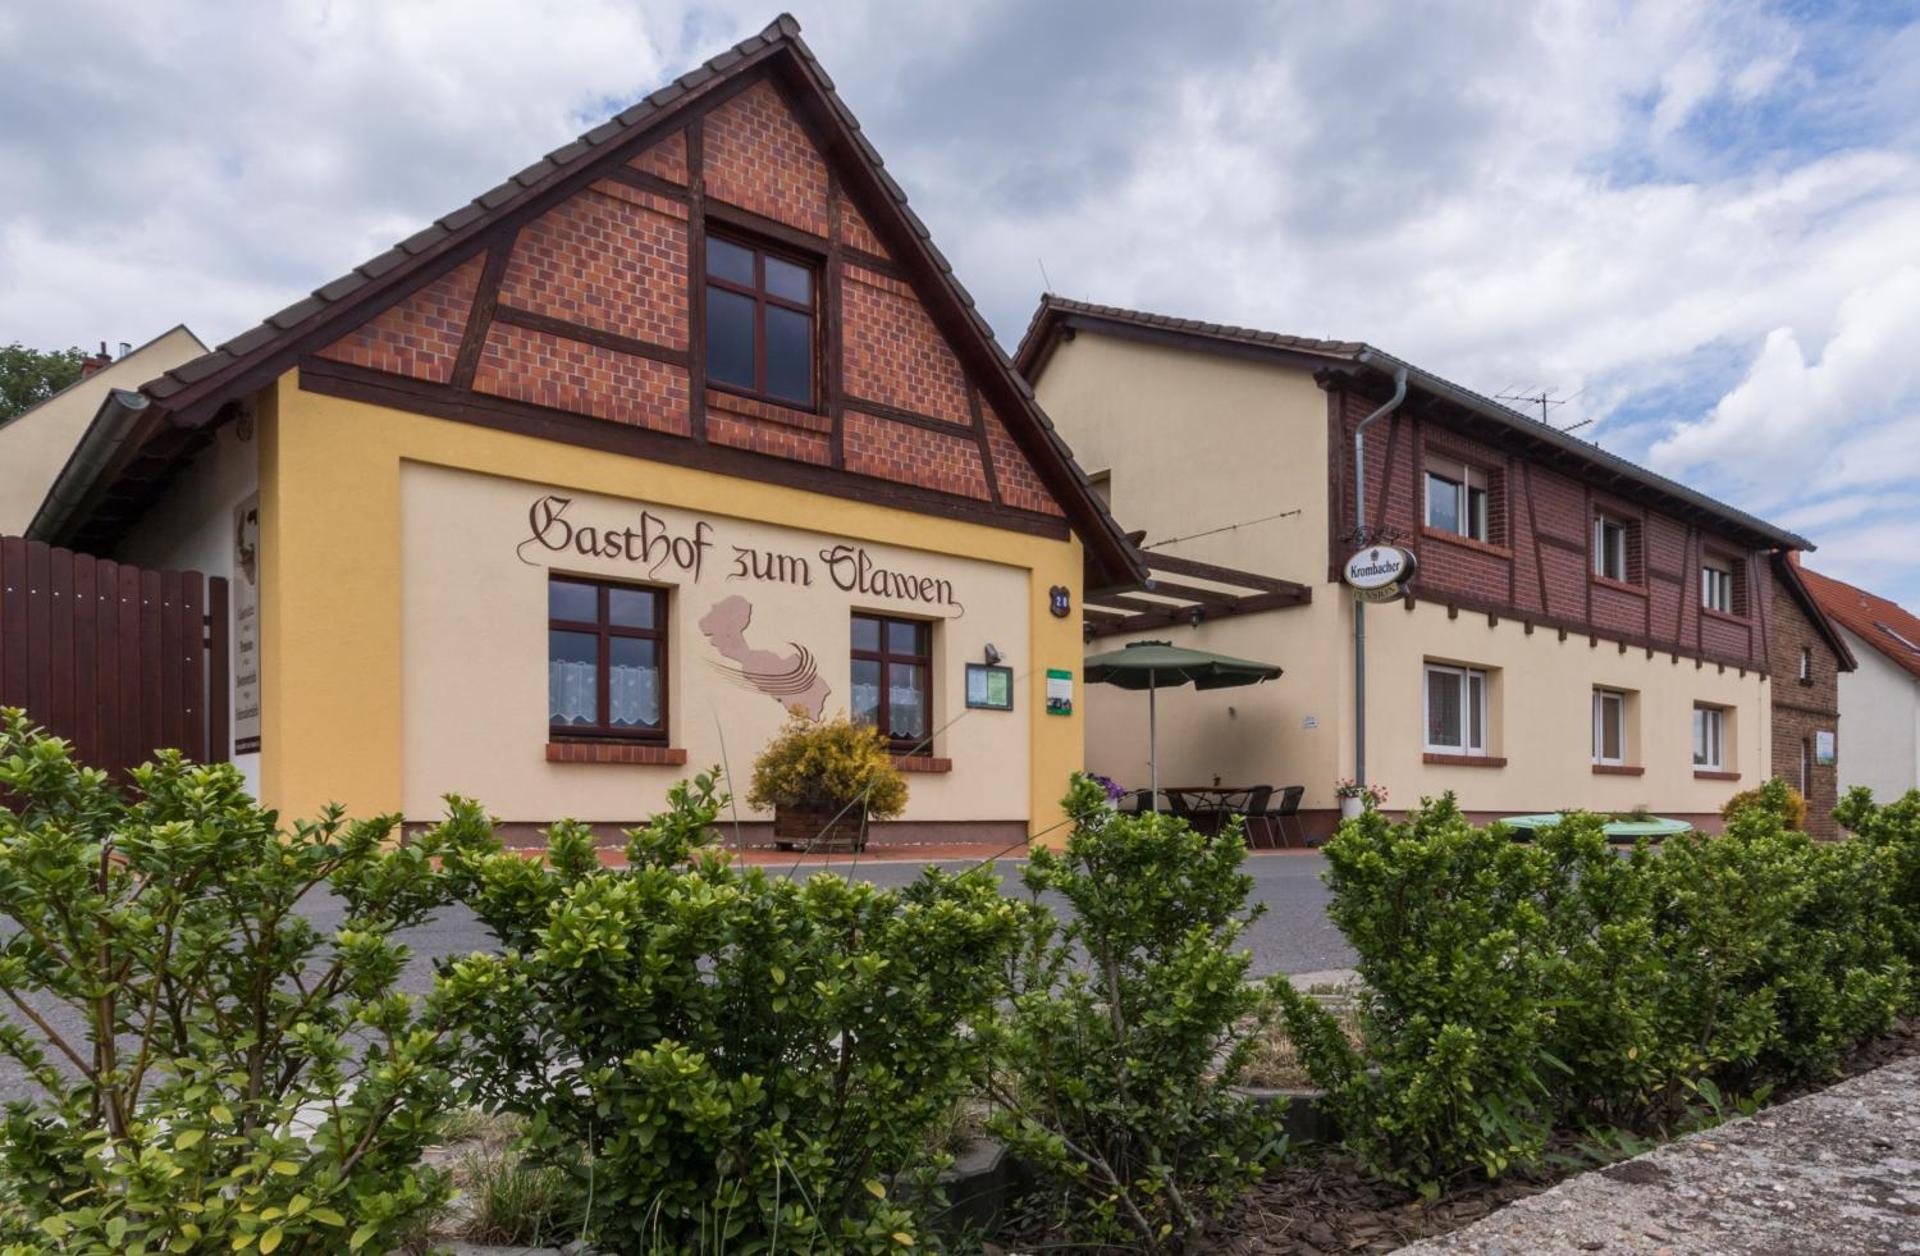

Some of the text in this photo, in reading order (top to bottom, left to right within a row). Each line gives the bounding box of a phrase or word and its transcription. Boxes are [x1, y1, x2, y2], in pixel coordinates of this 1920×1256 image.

[517, 496, 964, 619] Gasthof zum Slawen
[1350, 560, 1400, 578] Krombacher
